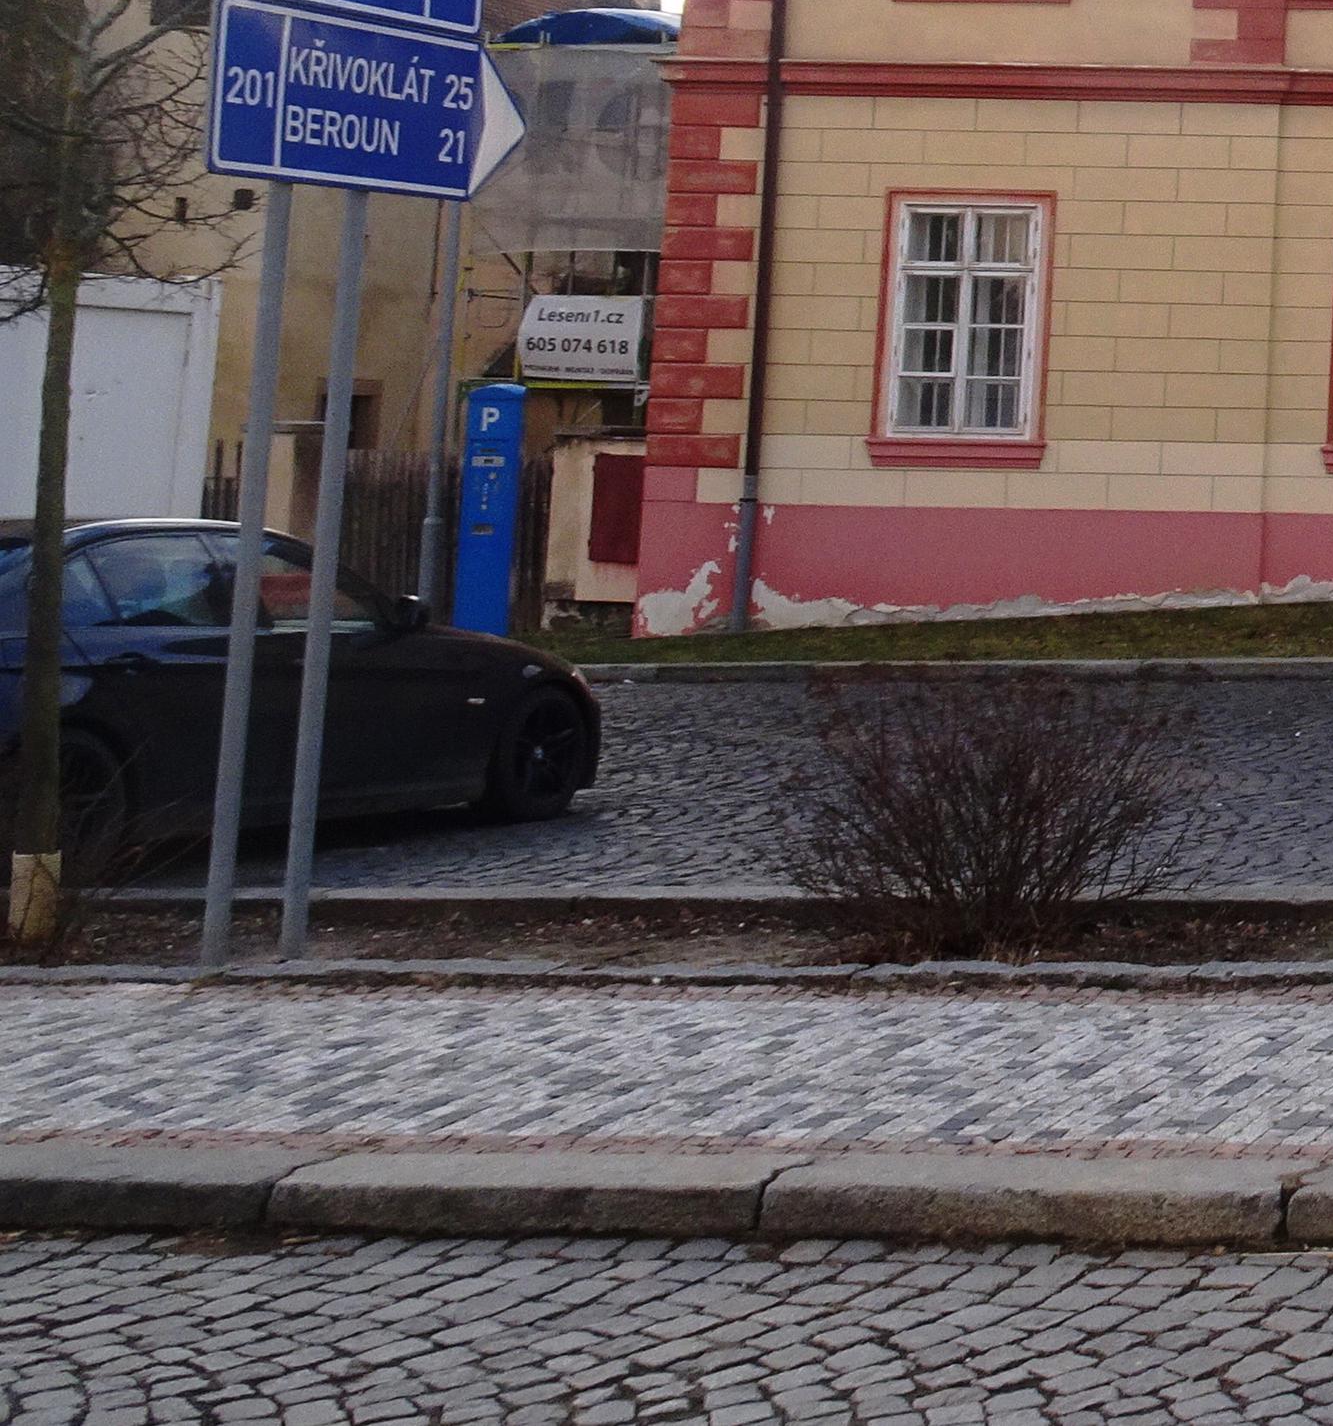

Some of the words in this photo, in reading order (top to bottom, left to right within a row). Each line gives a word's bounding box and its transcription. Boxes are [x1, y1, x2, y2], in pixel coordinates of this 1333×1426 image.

[226, 66, 275, 108] 201
[288, 40, 435, 105] KŘIVOKLÁT
[443, 74, 474, 111] 25
[285, 105, 400, 155] BEROUN
[438, 128, 465, 164] 21
[526, 337, 557, 352] 605
[561, 338, 592, 354] 074
[597, 339, 630, 355] 618
[481, 407, 500, 431] P
